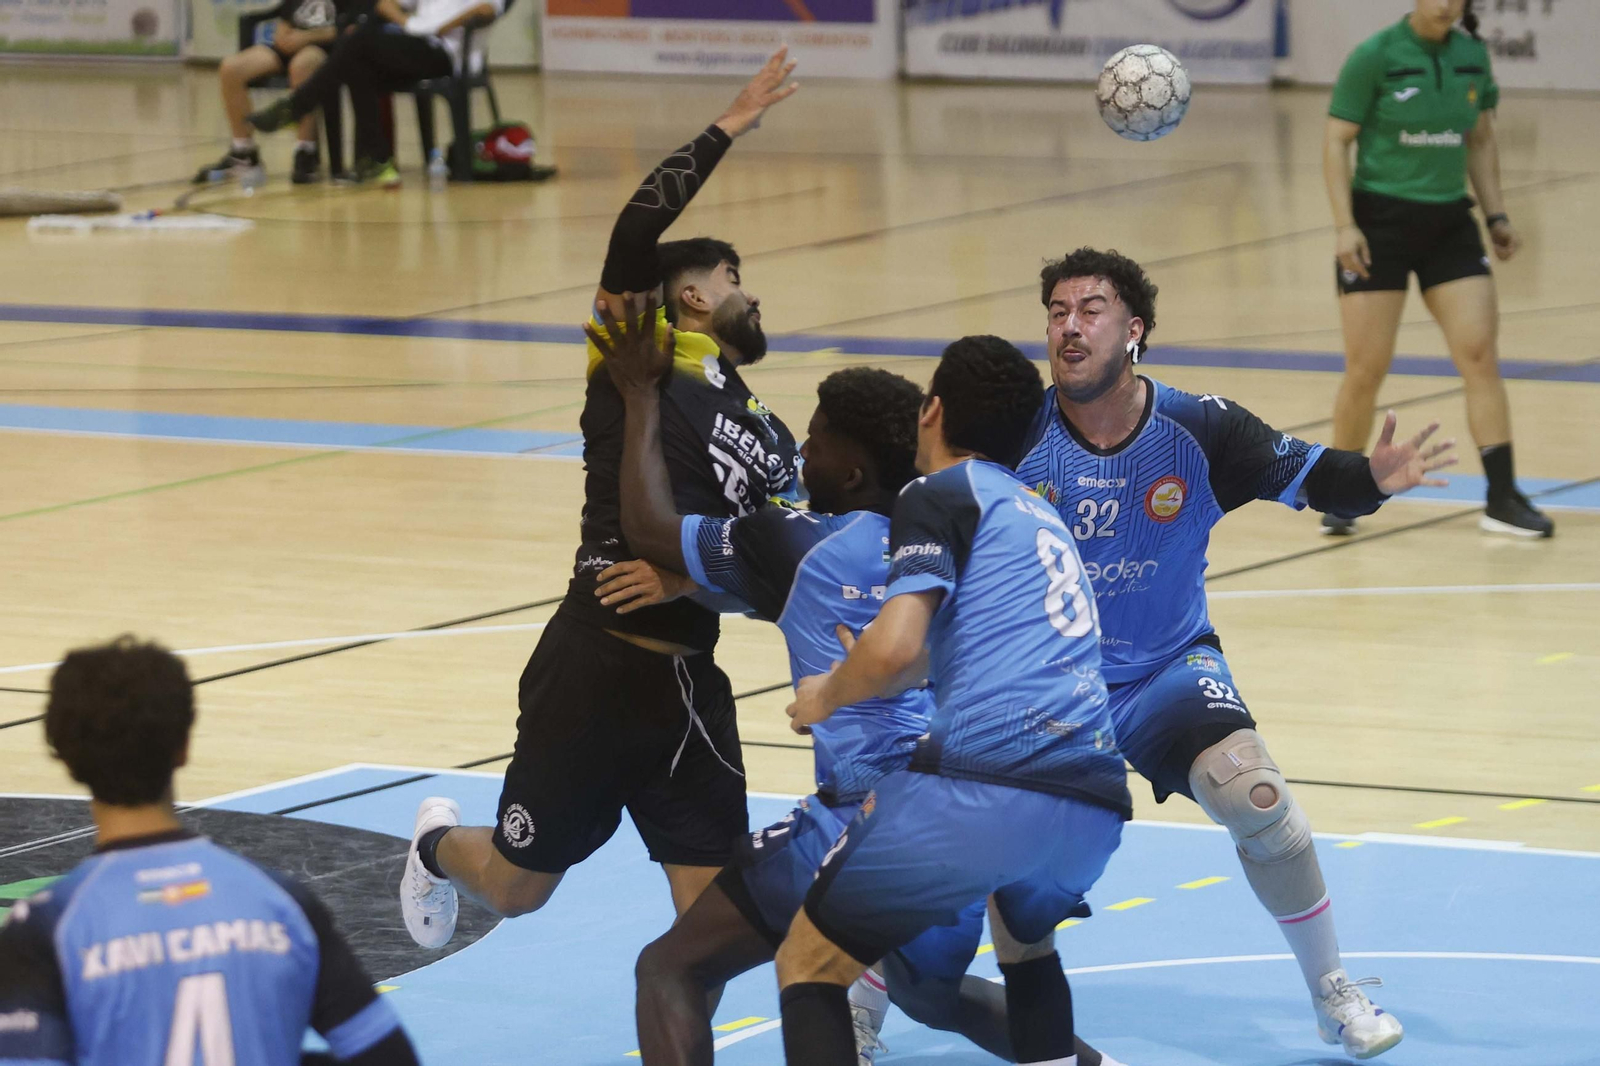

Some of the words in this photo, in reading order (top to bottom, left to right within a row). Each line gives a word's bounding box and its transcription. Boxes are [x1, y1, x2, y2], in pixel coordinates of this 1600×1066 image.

[1073, 498, 1120, 541] 32
[1036, 527, 1094, 638] 8
[1197, 676, 1240, 705] 32
[81, 931, 165, 981] XAVI
[166, 918, 292, 964] CAMAS
